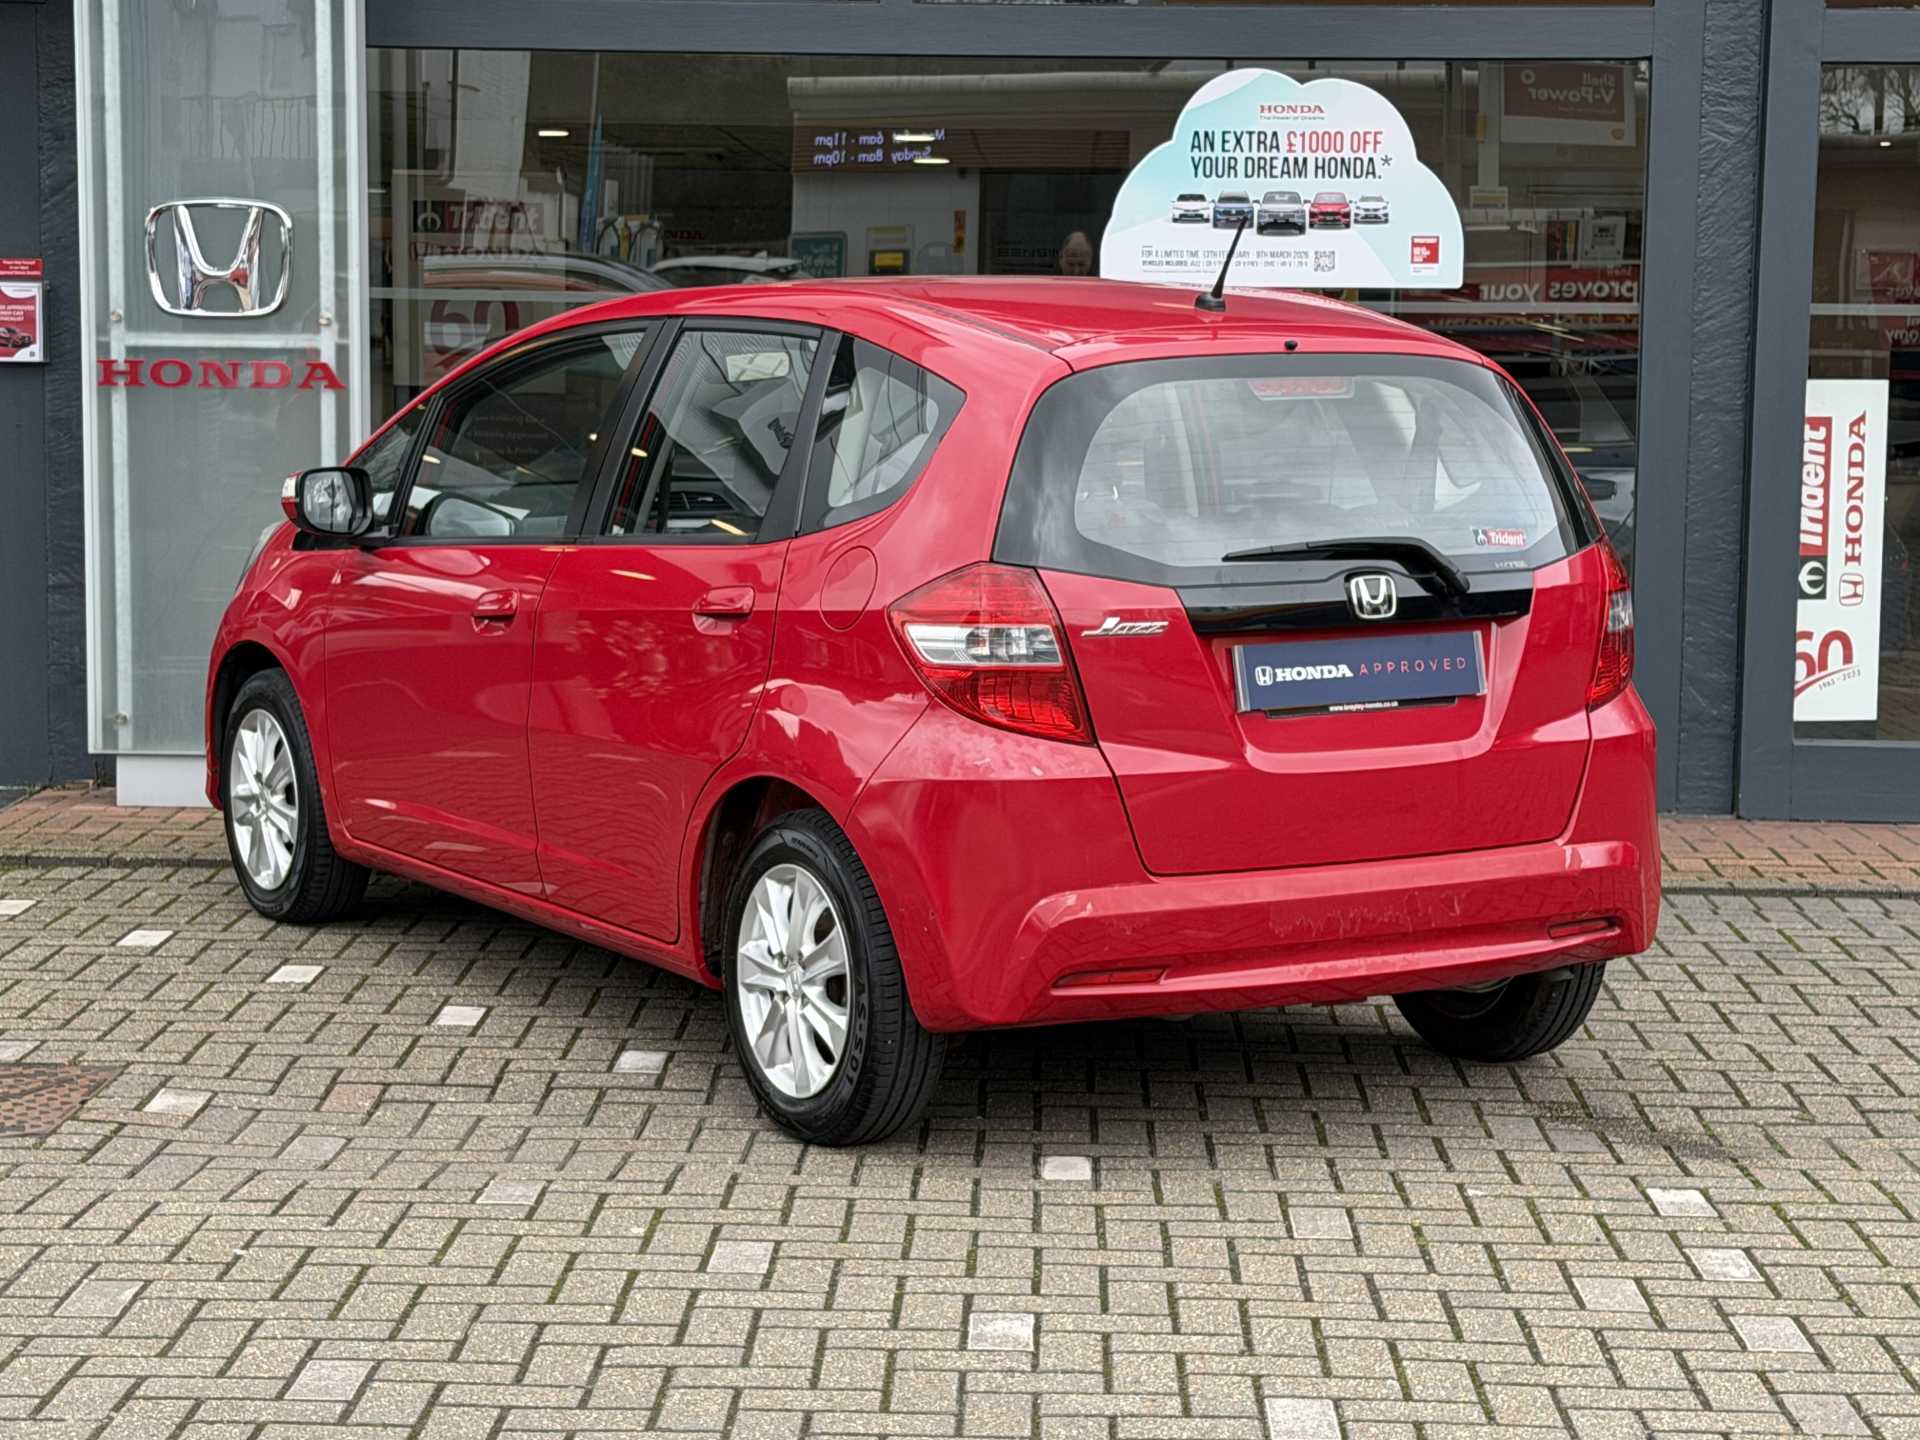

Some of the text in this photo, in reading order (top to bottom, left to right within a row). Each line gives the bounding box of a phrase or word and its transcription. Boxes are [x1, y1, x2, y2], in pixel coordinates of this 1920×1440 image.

[1259, 105, 1325, 114] HONDA
[1190, 131, 1383, 153] AN EXTRA £1000 OFF
[1190, 156, 1238, 179] YOUR
[1244, 156, 1308, 179] DREAM
[97, 359, 347, 389] HONDA
[1844, 410, 1867, 567] HONDA
[1488, 531, 1526, 547] Trident
[1275, 656, 1466, 682] HONDA APPROVED
